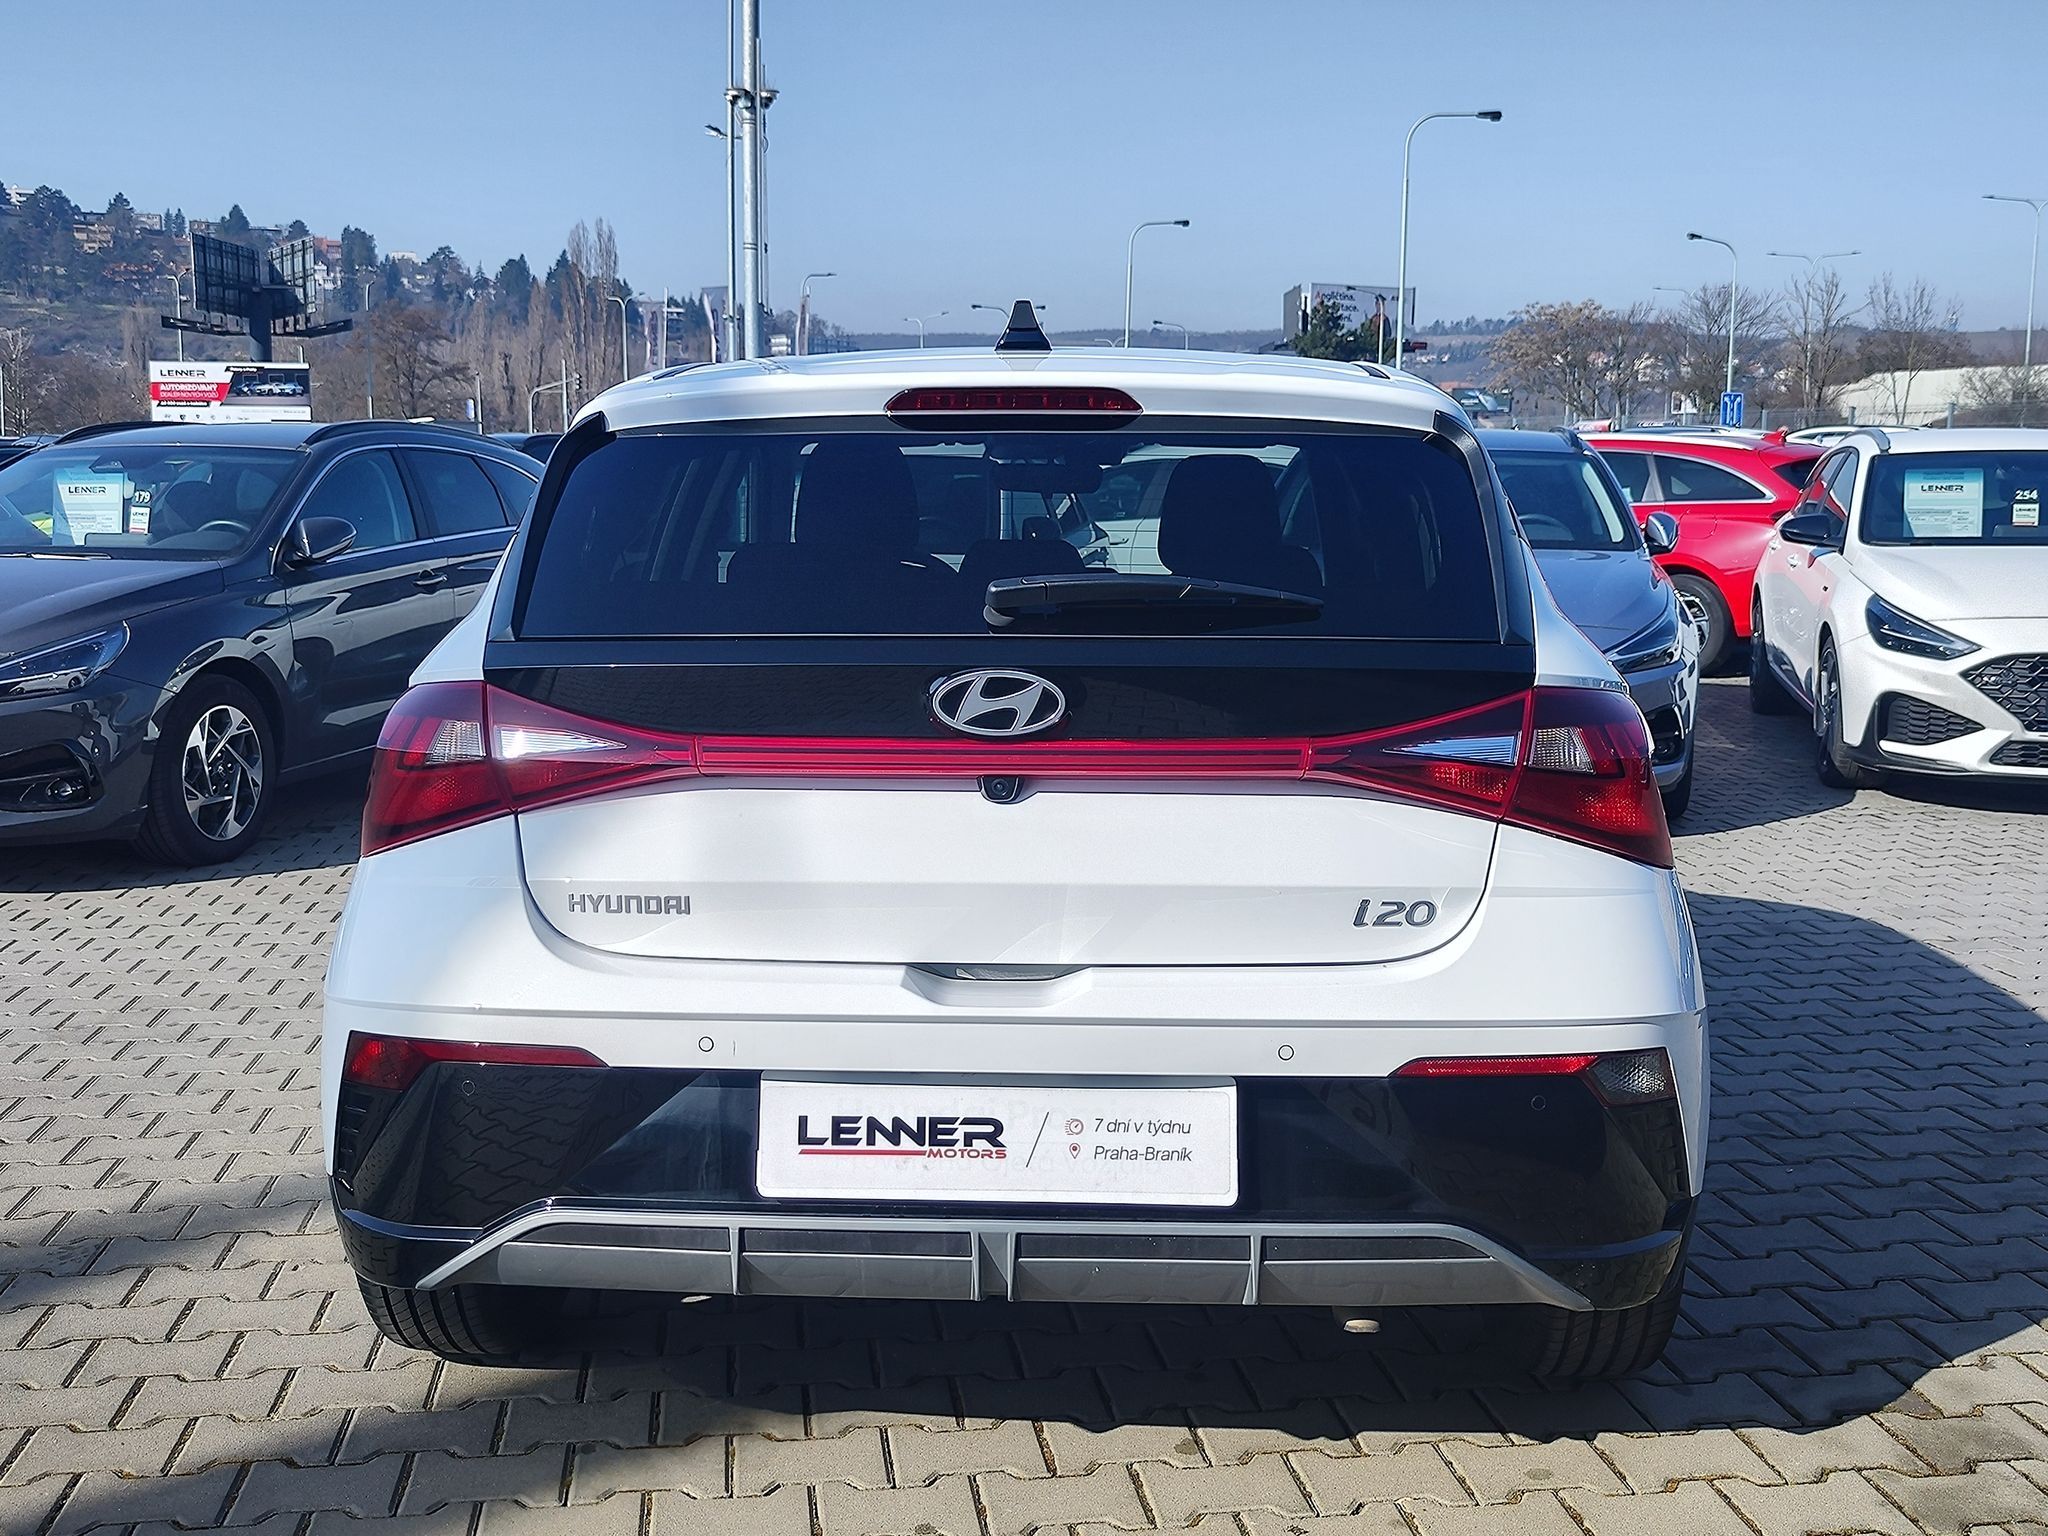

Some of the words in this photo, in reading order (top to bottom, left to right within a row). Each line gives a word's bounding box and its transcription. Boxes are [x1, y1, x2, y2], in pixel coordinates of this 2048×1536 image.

[160, 369, 206, 378] LENNER
[69, 486, 107, 494] LENNER
[1920, 484, 1964, 492] LENNER
[134, 490, 151, 502] 179
[2014, 489, 2038, 500] 254
[568, 893, 691, 915] HYUNDAI
[1353, 899, 1438, 928] i20
[798, 1115, 1007, 1148] LENNER
[1094, 1118, 1104, 1133] 7
[1106, 1118, 1132, 1133] dní
[1134, 1121, 1144, 1133] v
[1147, 1119, 1192, 1137] týdnu
[926, 1148, 1008, 1159] MOTORS
[1094, 1145, 1192, 1162] Praha-Braník
